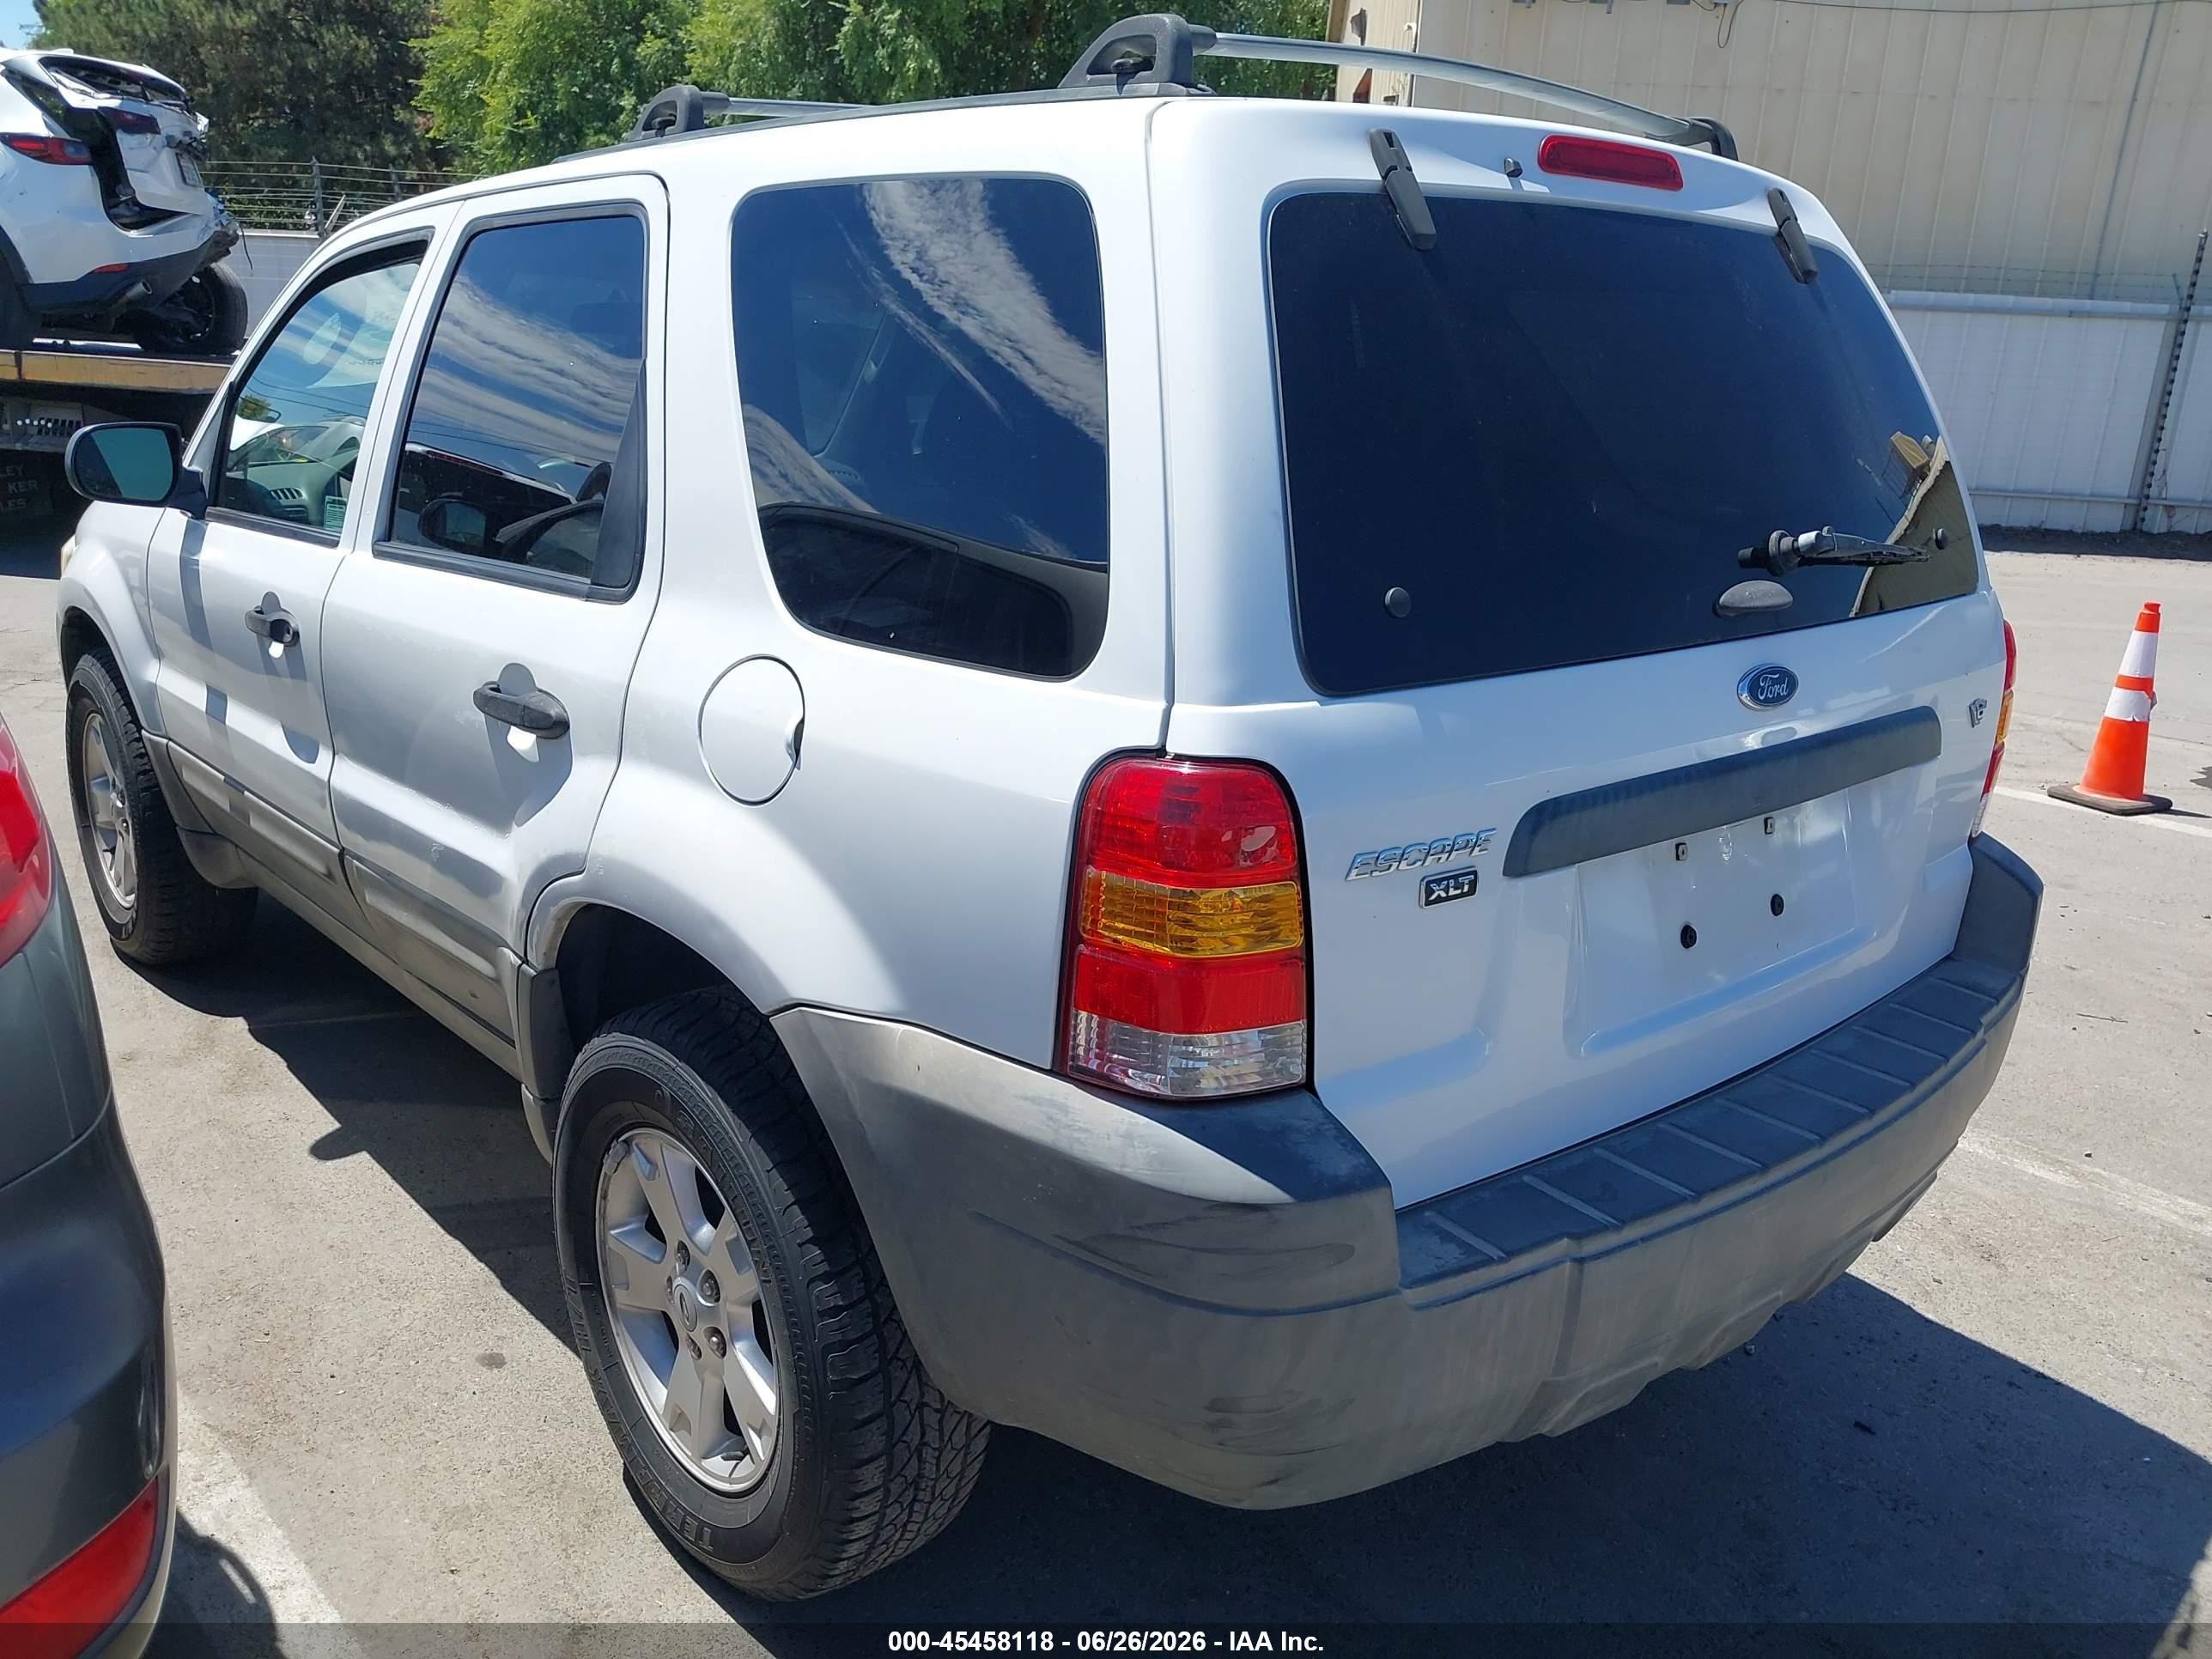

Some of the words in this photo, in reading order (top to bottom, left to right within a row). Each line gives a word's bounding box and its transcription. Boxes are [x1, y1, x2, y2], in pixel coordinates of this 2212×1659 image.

[1757, 672, 1790, 701] Ford
[1345, 827, 1497, 881] ESCAPE
[1428, 874, 1474, 901] XLT
